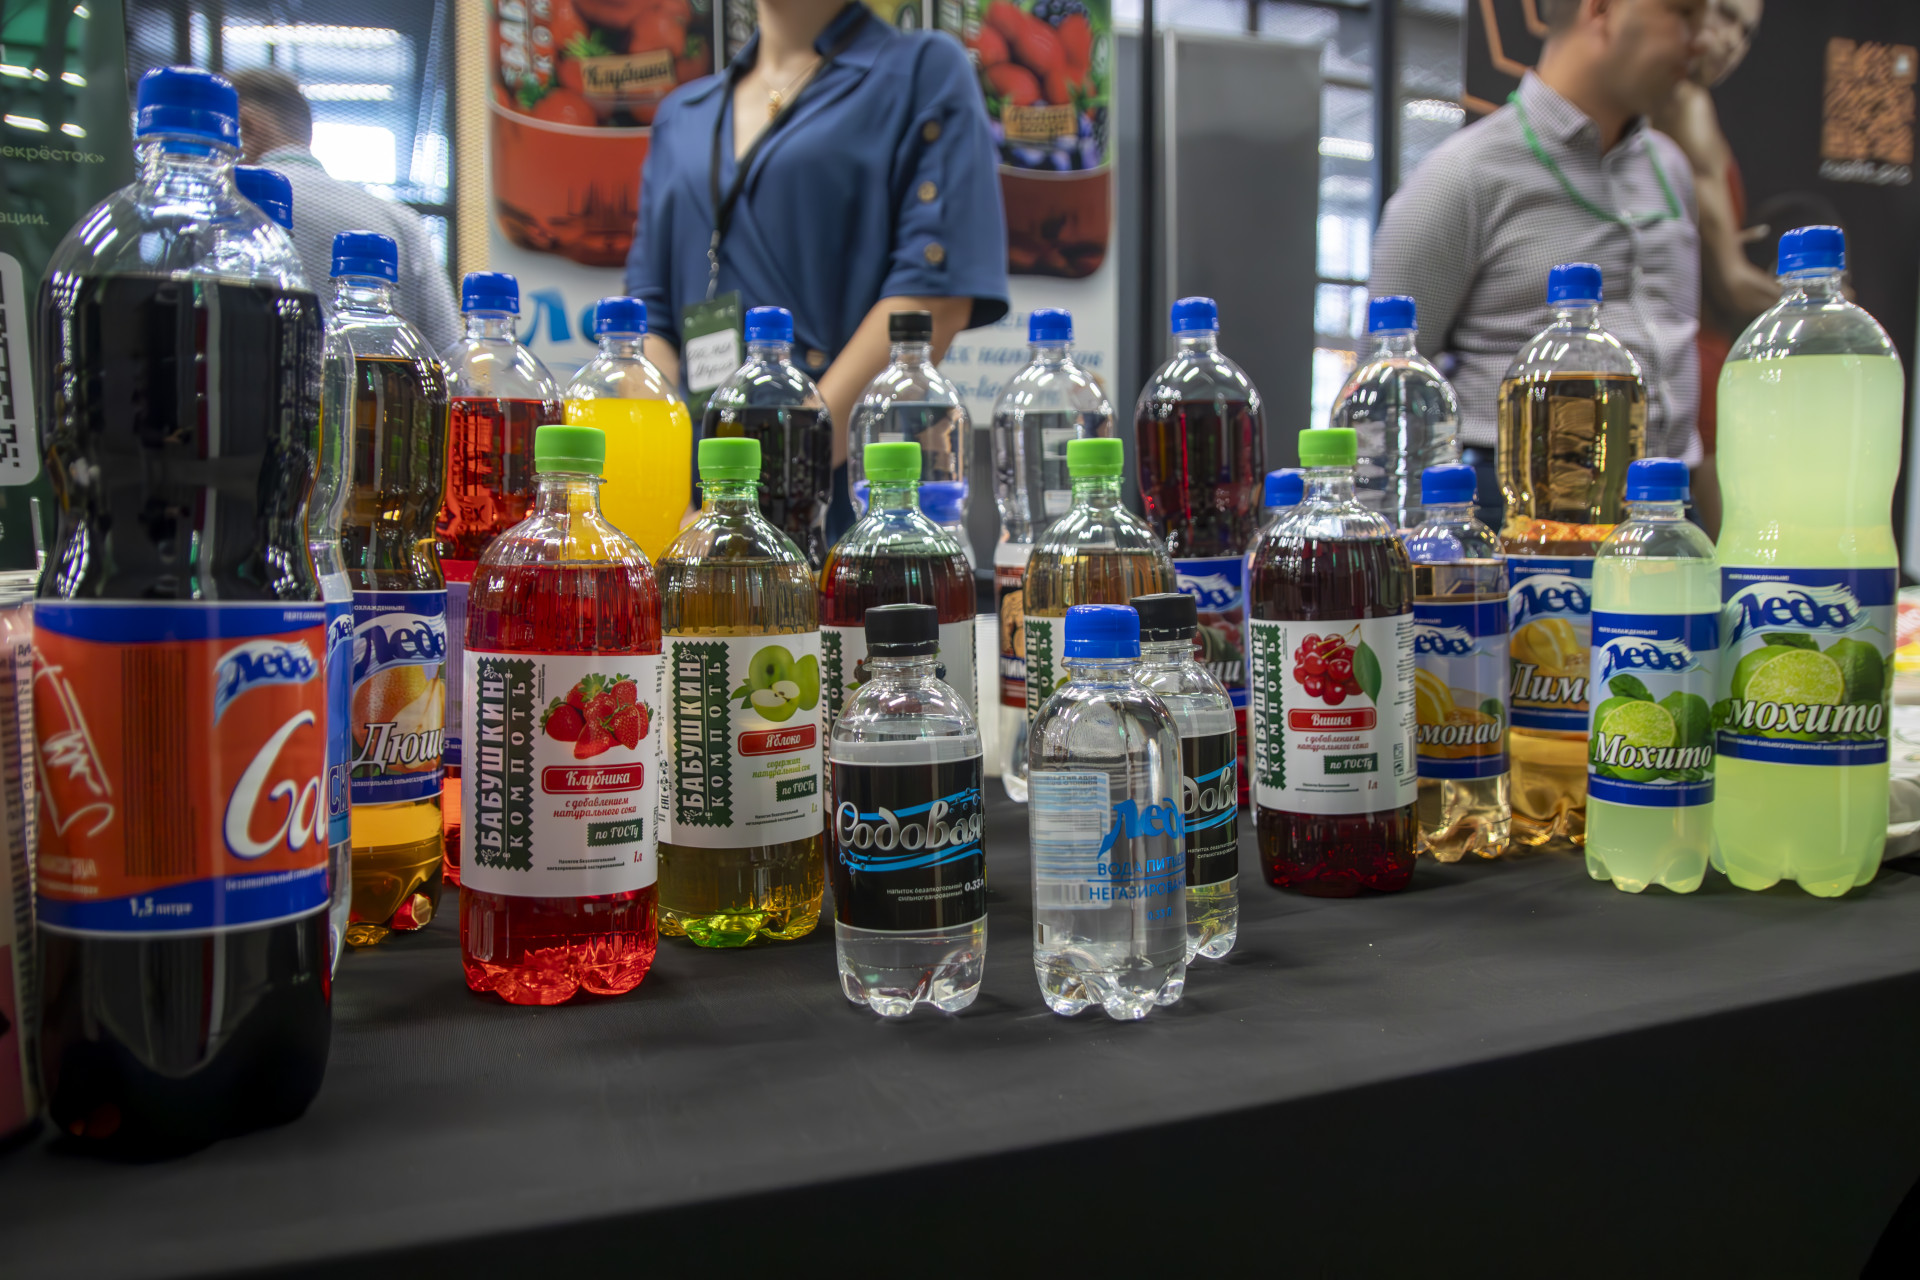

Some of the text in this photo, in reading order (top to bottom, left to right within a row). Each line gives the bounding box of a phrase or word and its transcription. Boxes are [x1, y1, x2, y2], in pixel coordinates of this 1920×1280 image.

[0, 145, 105, 162] екрёсток»
[1511, 582, 1591, 633] Лед
[1731, 590, 1856, 645] Леда
[1414, 629, 1472, 655] еда
[226, 646, 313, 700] Леда
[1601, 643, 1691, 683] Леда
[1267, 642, 1281, 772] КОМПОТЪ
[1311, 713, 1352, 726] Вишня
[679, 662, 704, 811] БАБУШКИН
[709, 662, 724, 807] КОМПОТЪ
[766, 734, 801, 748] Яблоко
[1593, 731, 1713, 770] Мохито
[481, 680, 504, 850] БАБУШКИН
[510, 681, 526, 848] КОМПОТЪ
[1343, 757, 1373, 770] ГОСТу
[565, 770, 631, 790] Клубника
[782, 780, 815, 796] по ГОСТу
[553, 806, 637, 819] натурального сока
[572, 797, 629, 809] добавлением
[595, 825, 639, 840] по ГОСТу
[836, 799, 983, 851] Содовая
[633, 850, 642, 863] 1л
[1097, 861, 1142, 876] ВОДА
[130, 897, 154, 918] 1,5
